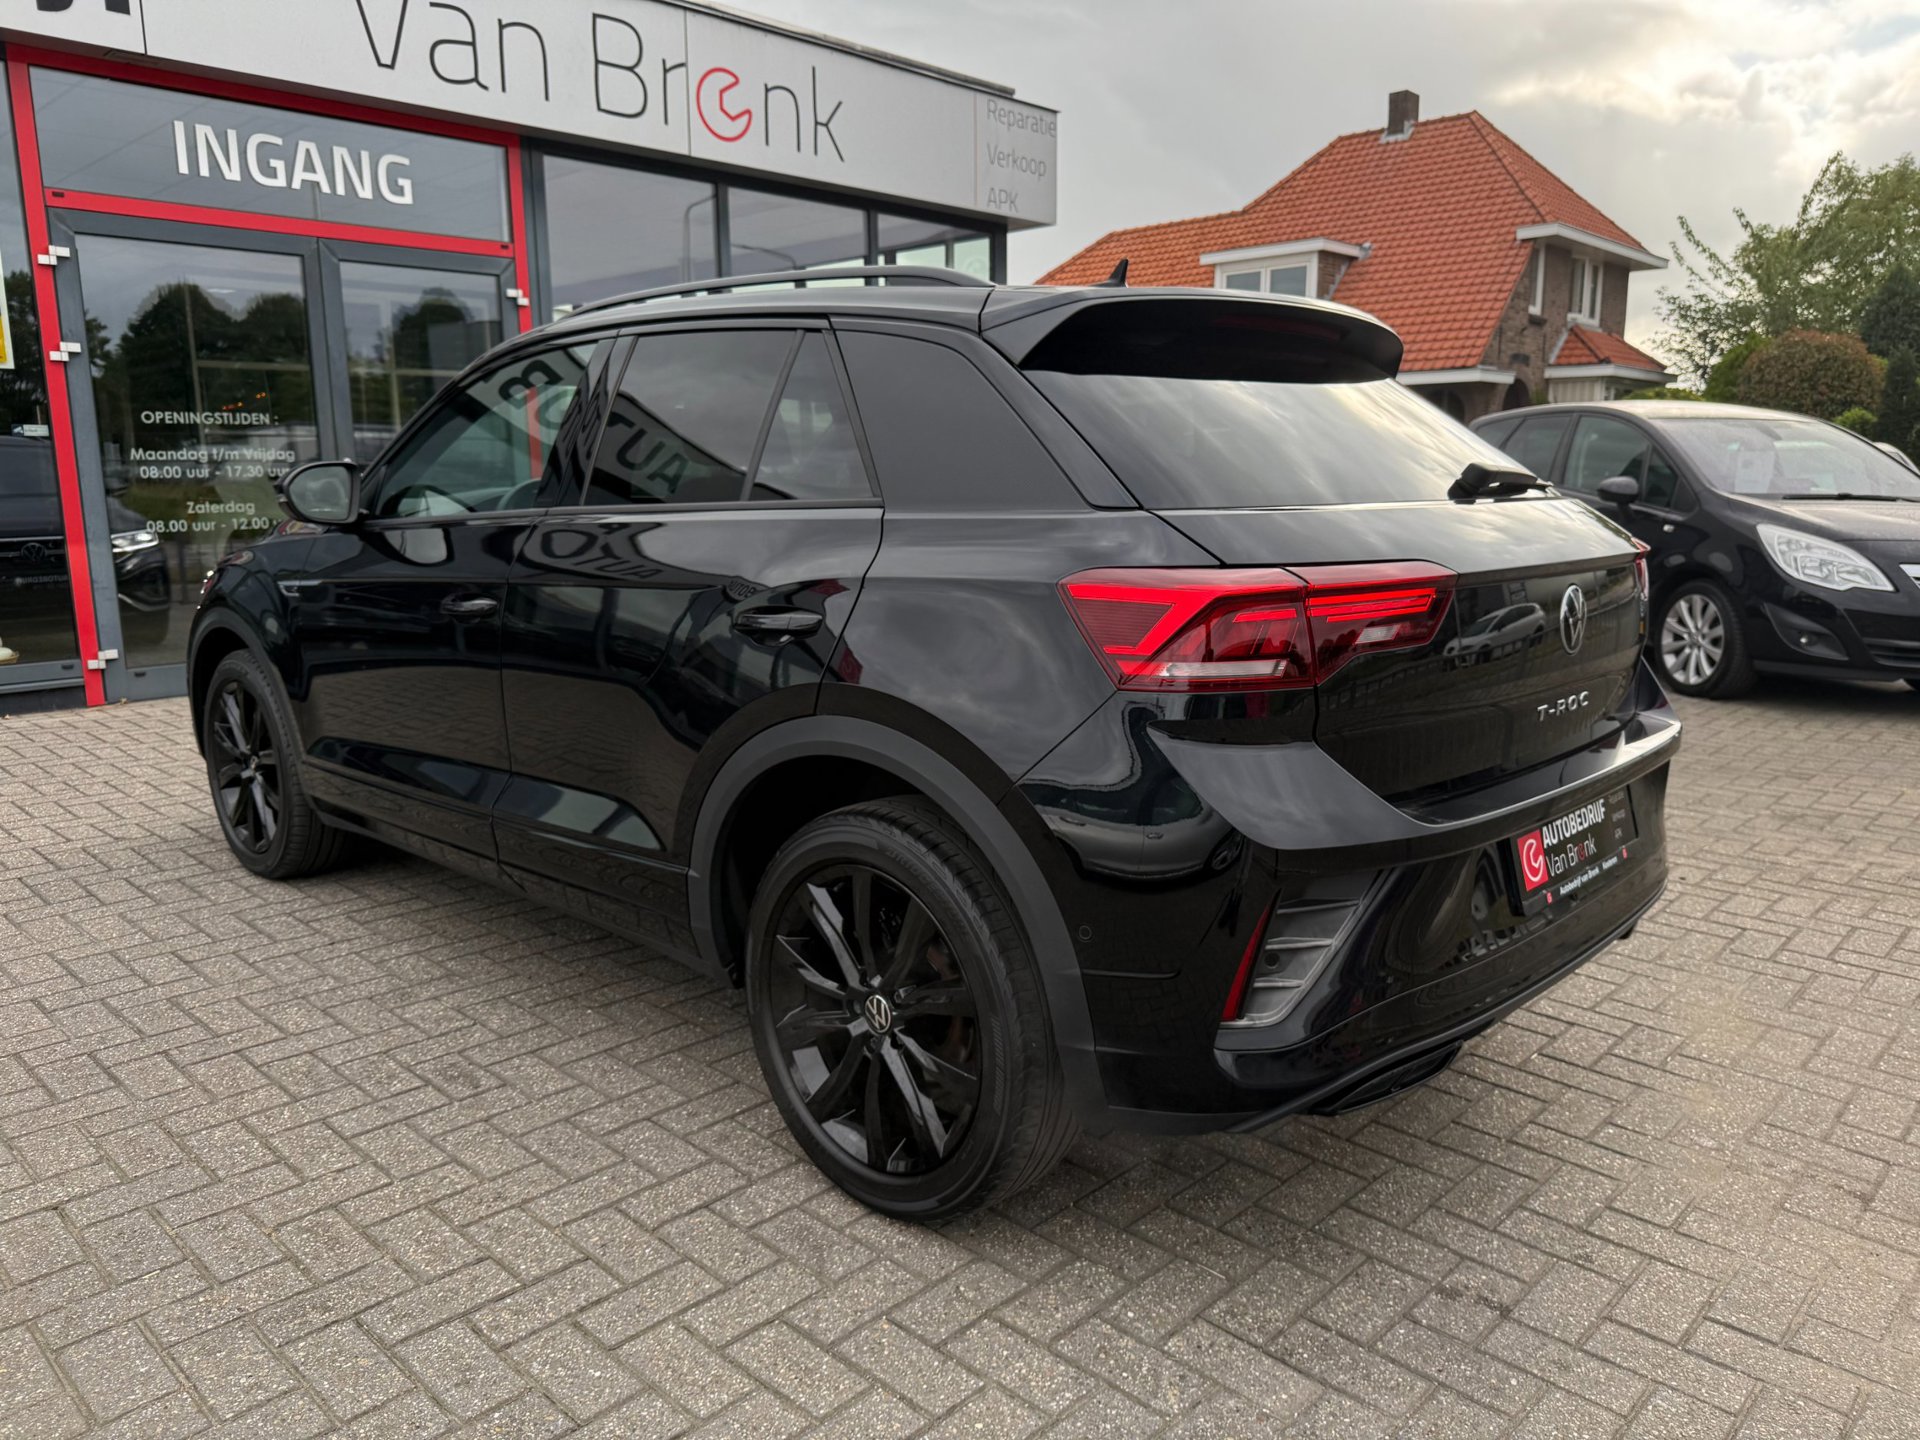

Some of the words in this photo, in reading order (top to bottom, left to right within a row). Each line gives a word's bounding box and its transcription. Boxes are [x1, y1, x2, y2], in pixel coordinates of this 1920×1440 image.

[358, 0, 549, 102] Van
[986, 98, 1057, 139] Reparatie
[172, 120, 414, 205] INGANG
[986, 142, 1048, 182] Verkoop
[986, 187, 1019, 214] APK
[140, 410, 271, 426] OPENINGSTIJDEN
[130, 448, 208, 463] Maandag
[213, 449, 239, 461] t/m
[243, 449, 296, 463] Vrijdag
[186, 468, 211, 478] uur
[226, 465, 264, 478] 17.30
[186, 501, 256, 515] Zaterdag
[146, 519, 188, 533] 08.00
[192, 521, 217, 531] uur
[232, 517, 270, 530] 12.00
[1537, 691, 1589, 721] T-ROC
[1542, 799, 1606, 849] AUTOBEDRIJF
[1546, 852, 1569, 877] Van
